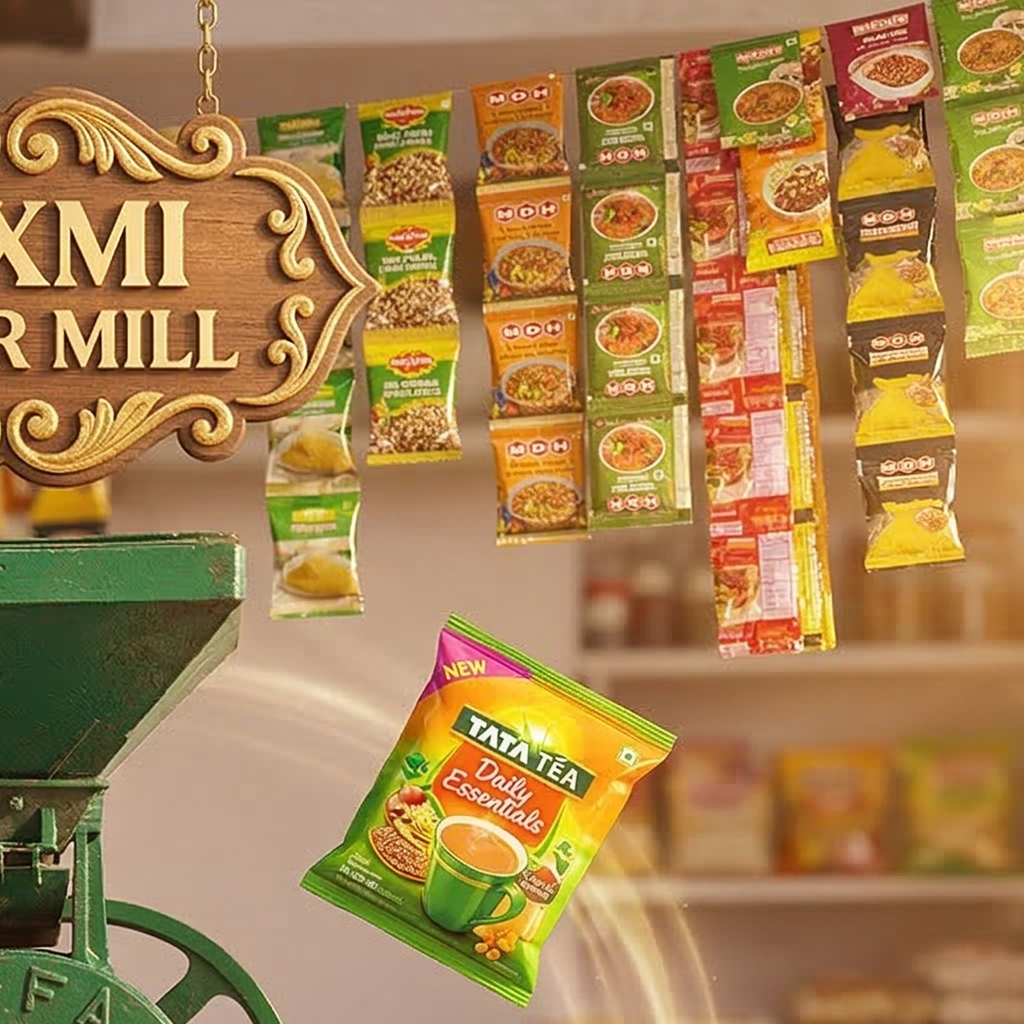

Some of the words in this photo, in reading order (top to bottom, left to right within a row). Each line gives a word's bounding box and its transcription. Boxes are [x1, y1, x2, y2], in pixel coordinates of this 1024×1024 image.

[52, 309, 240, 369] MILL
[443, 660, 486, 680] NEW
[469, 715, 531, 765] TATA
[442, 768, 545, 835] Essentials
[474, 757, 533, 808] Daily
